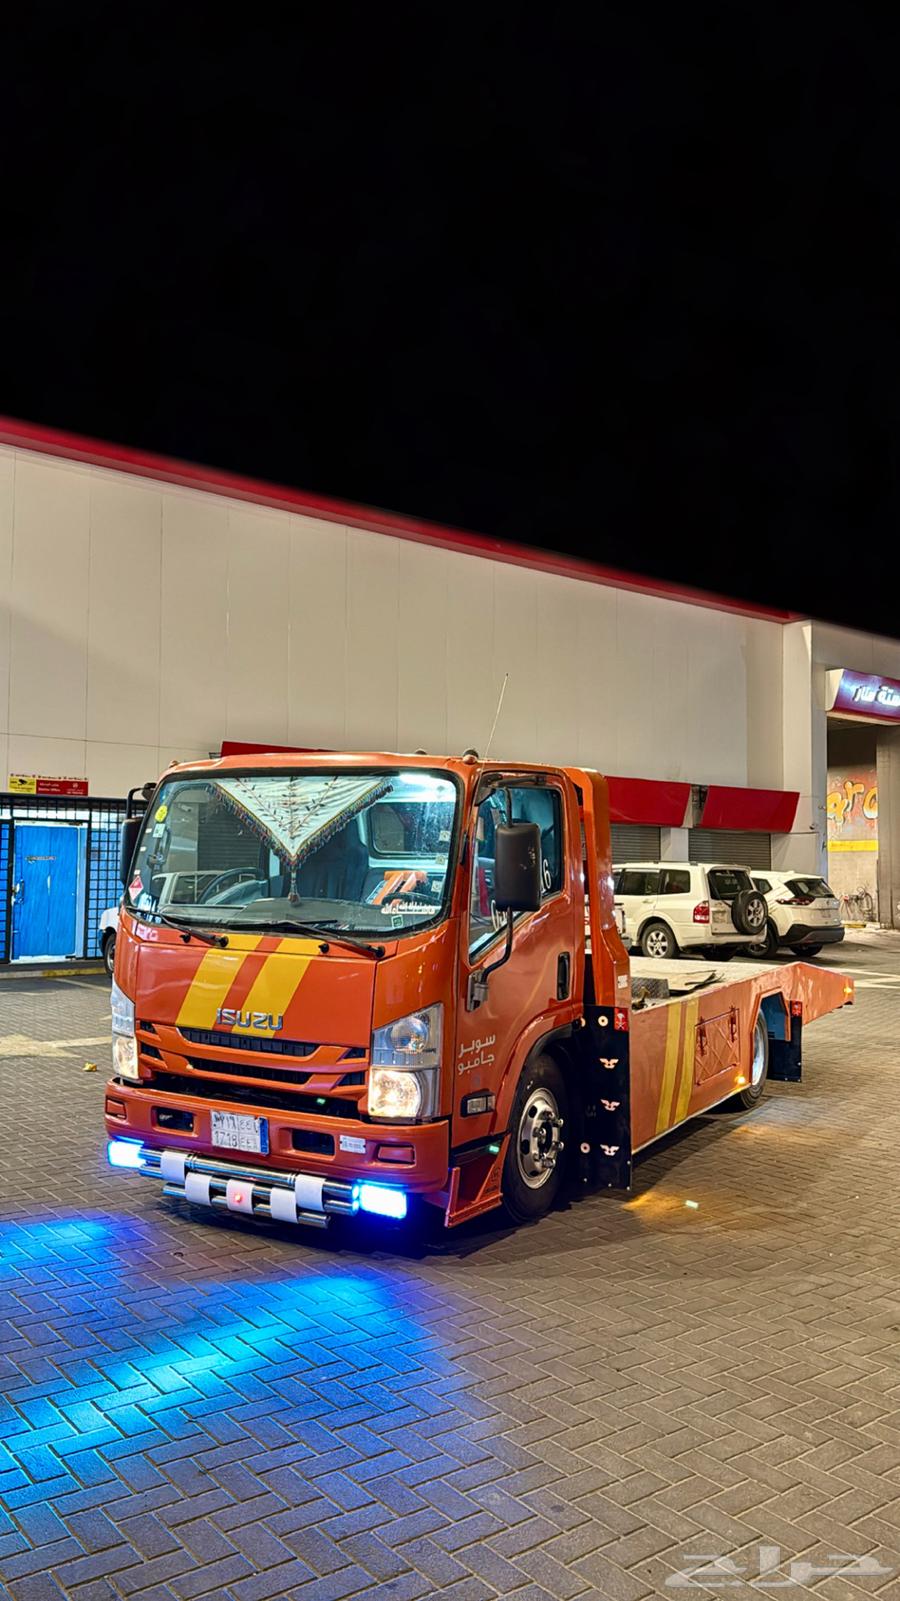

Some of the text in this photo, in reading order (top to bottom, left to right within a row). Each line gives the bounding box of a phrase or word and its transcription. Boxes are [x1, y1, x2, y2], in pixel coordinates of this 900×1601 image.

[216, 1007, 284, 1030] ISUZU
[458, 1034, 495, 1058] سوبر
[457, 1050, 494, 1075] جامبو
